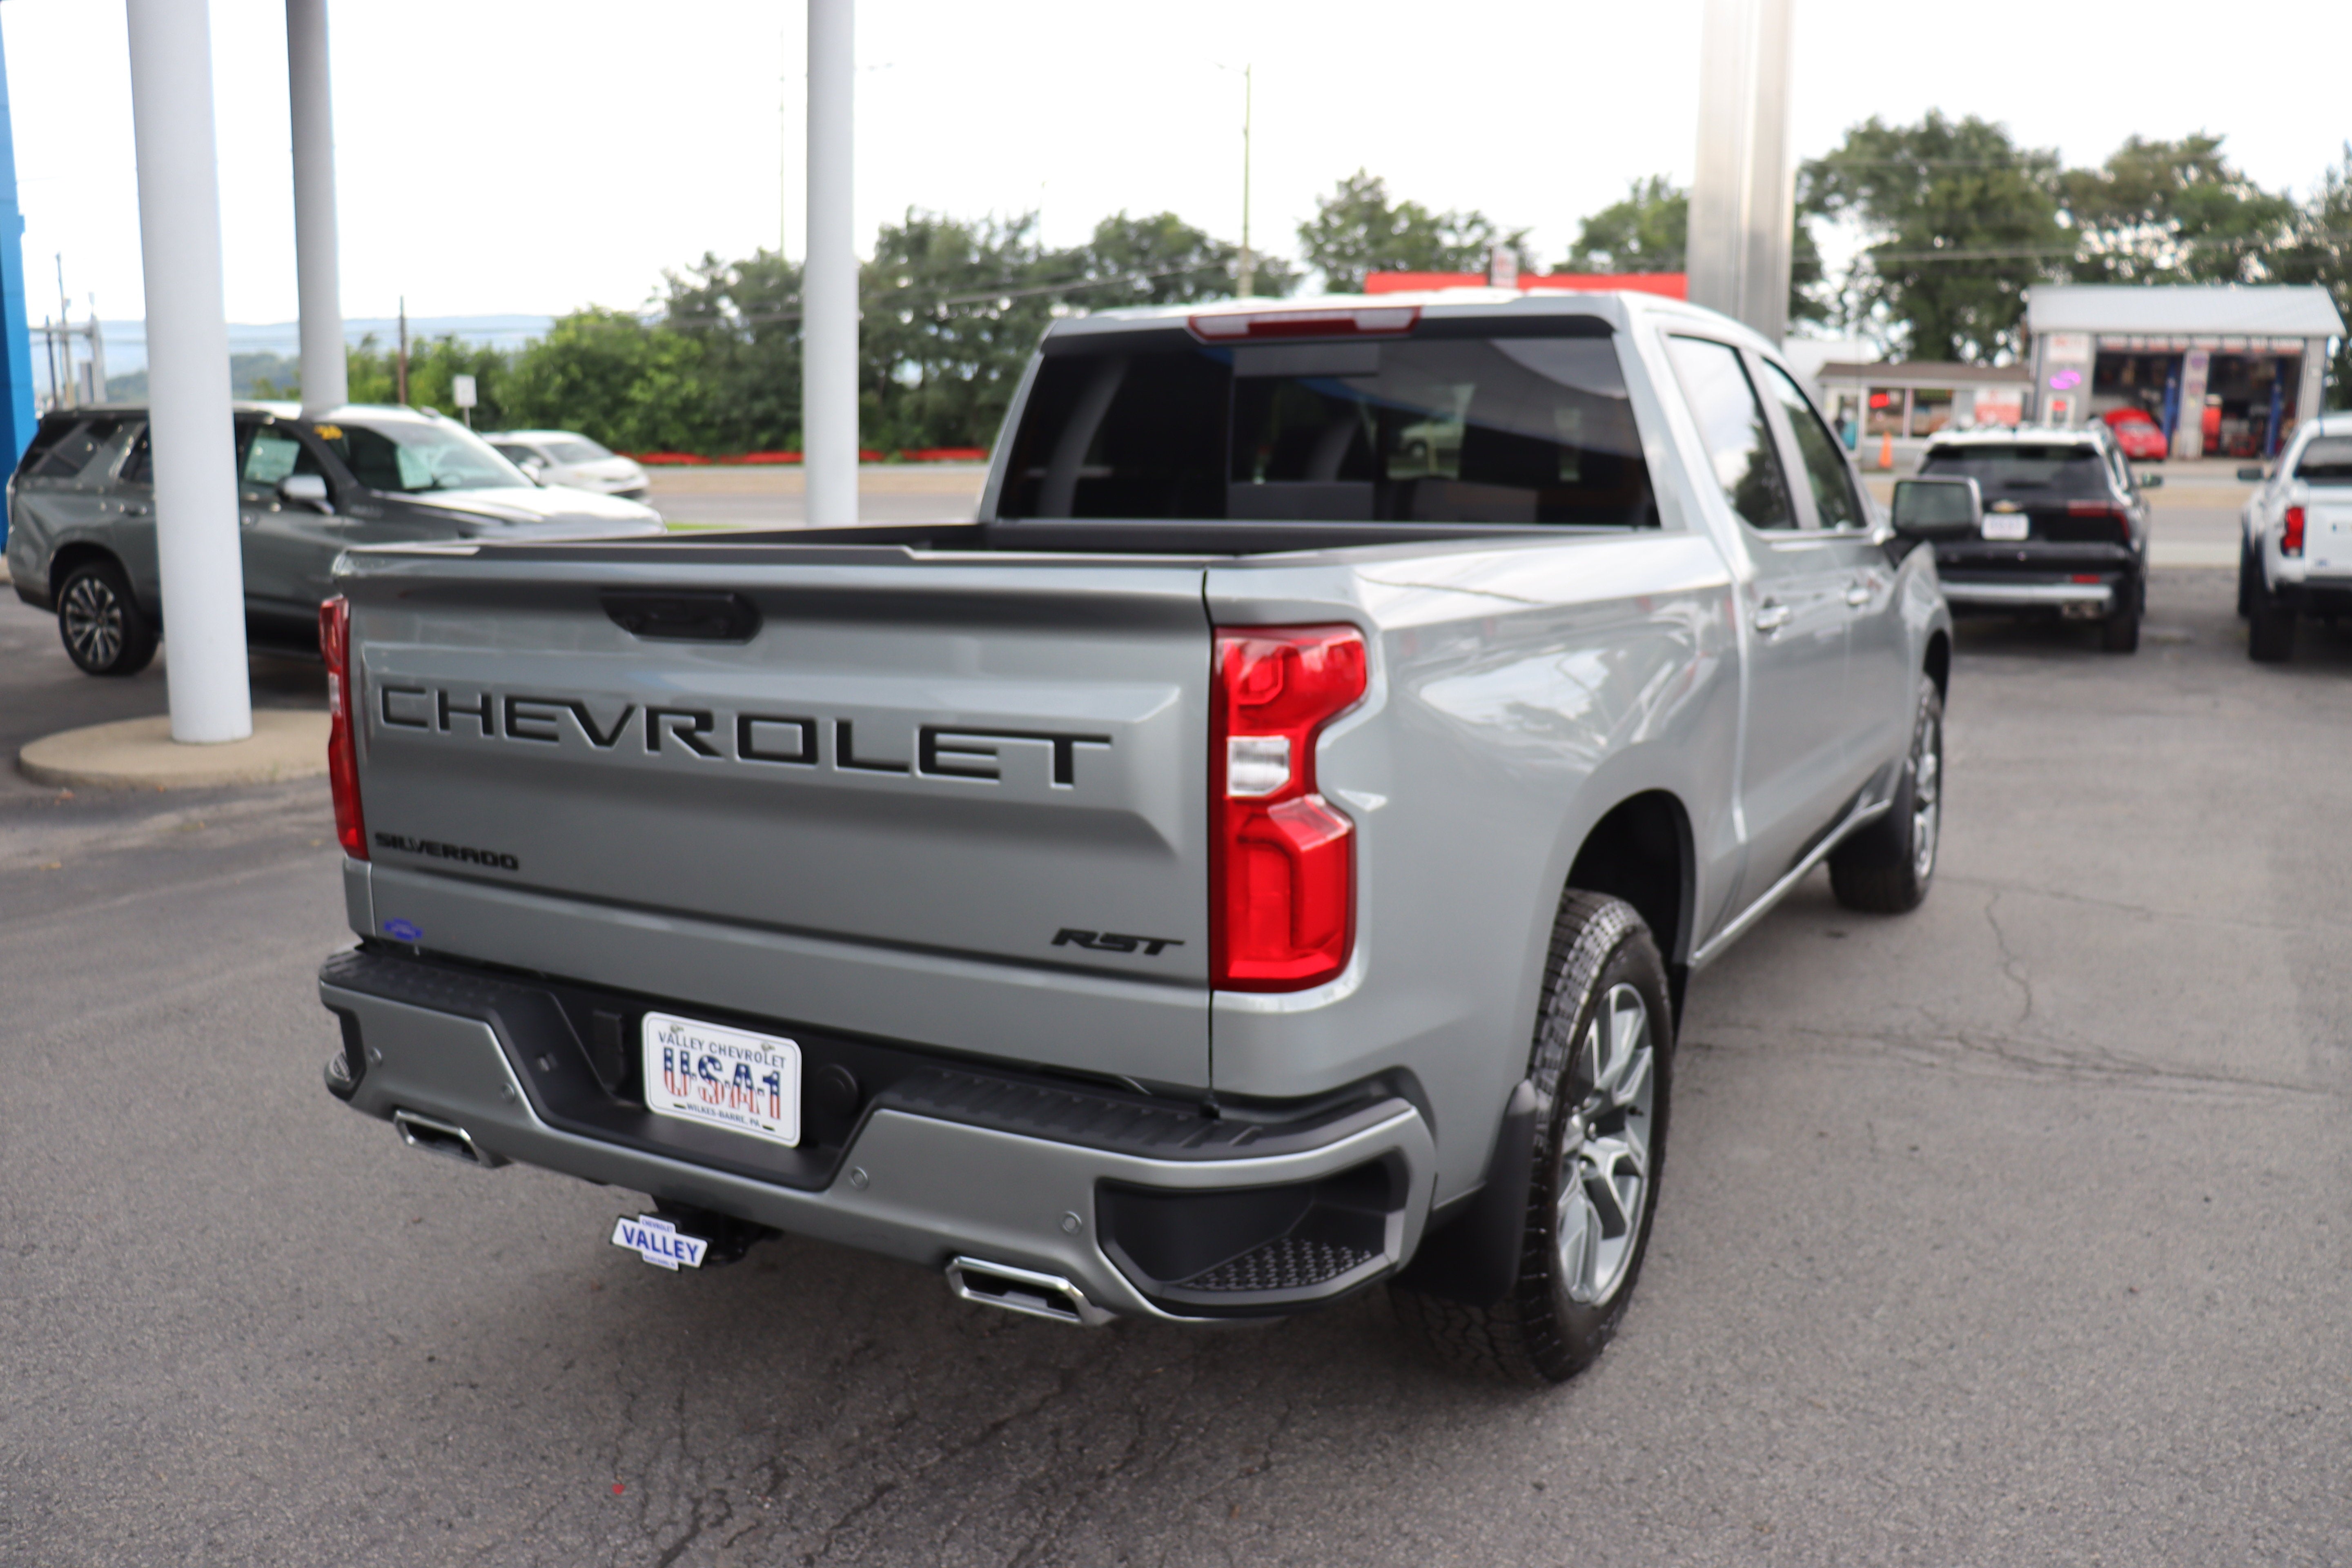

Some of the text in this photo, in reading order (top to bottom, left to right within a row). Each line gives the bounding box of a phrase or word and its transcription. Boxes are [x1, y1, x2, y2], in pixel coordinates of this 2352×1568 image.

[379, 685, 1113, 789] CHEVROLET
[374, 831, 520, 871] SILVERADO
[1051, 927, 1185, 956] RST
[659, 1031, 786, 1069] VALLEY CHEVROLET
[623, 1225, 699, 1263] VALLEY
